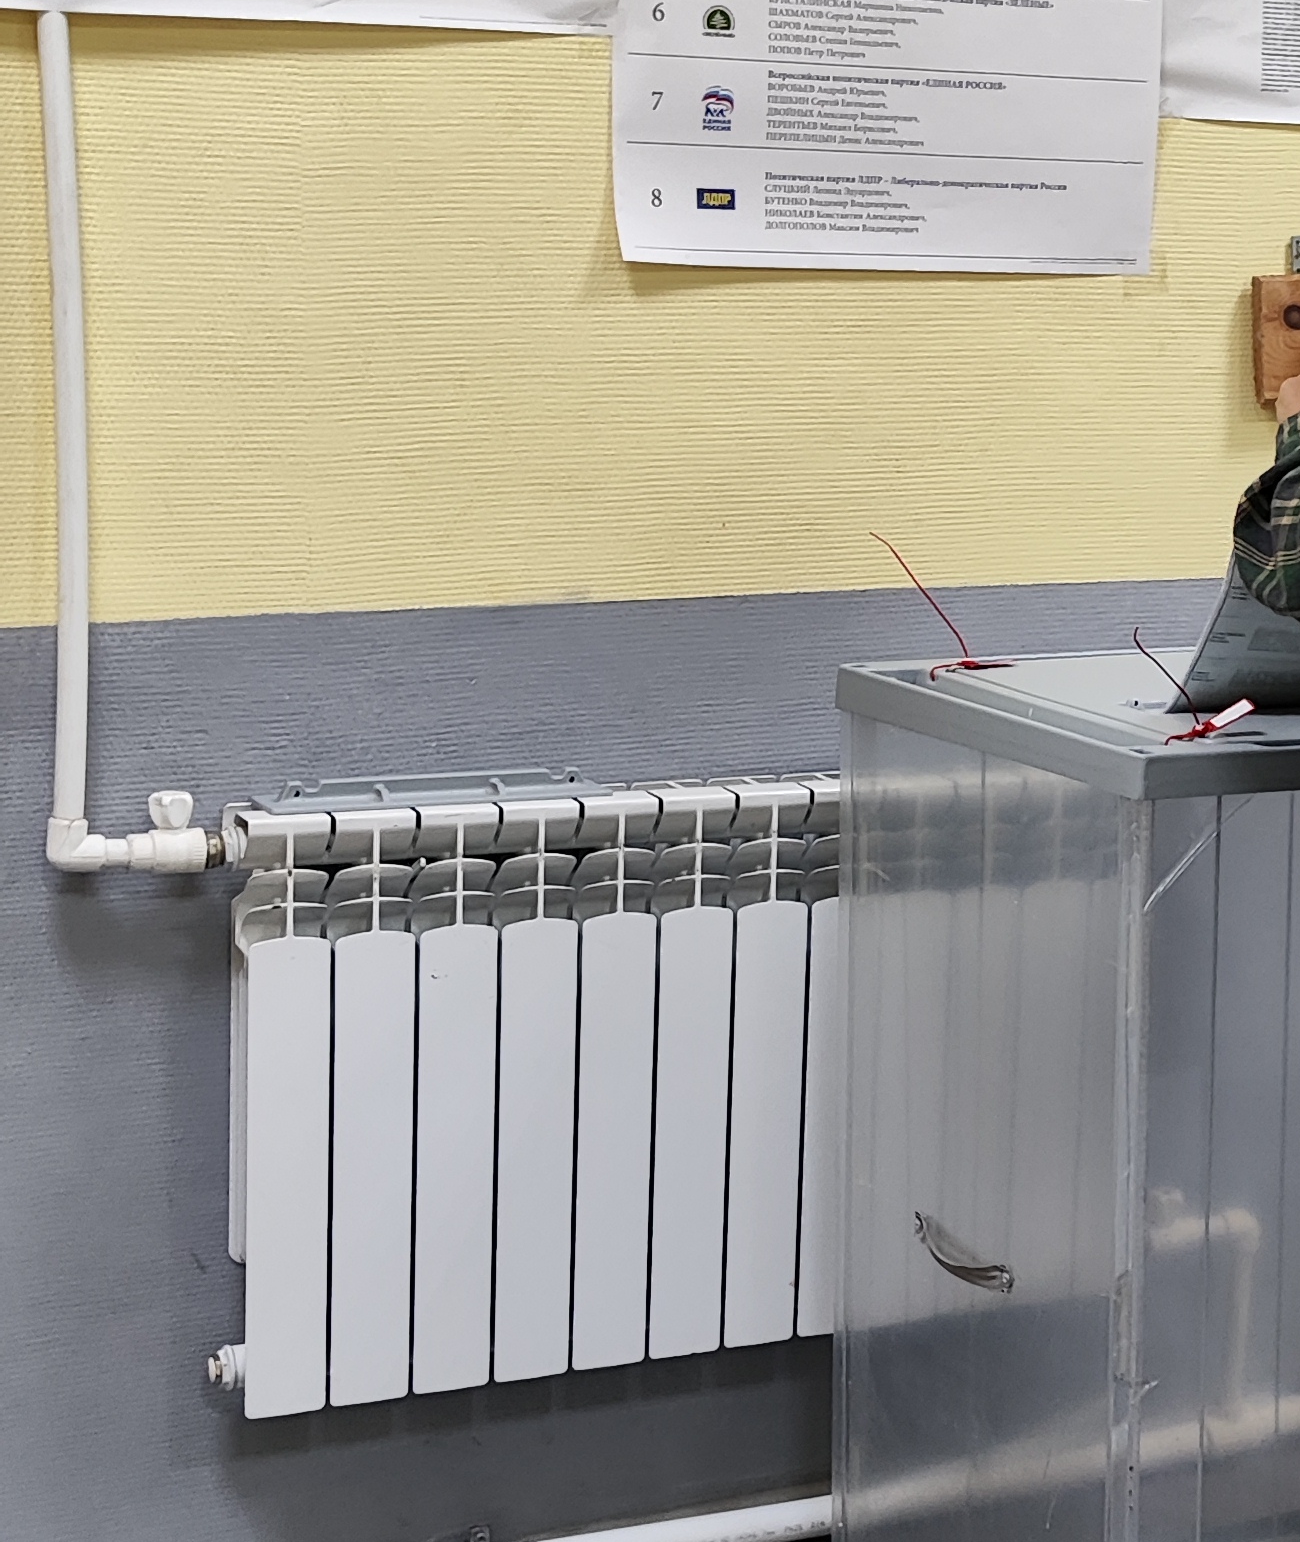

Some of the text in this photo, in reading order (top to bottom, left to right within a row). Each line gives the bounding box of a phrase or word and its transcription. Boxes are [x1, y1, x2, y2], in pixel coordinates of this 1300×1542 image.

[652, 2, 665, 22] 6
[768, 45, 802, 55] ПОПОВ
[651, 91, 663, 111] 7
[651, 188, 663, 207] 8
